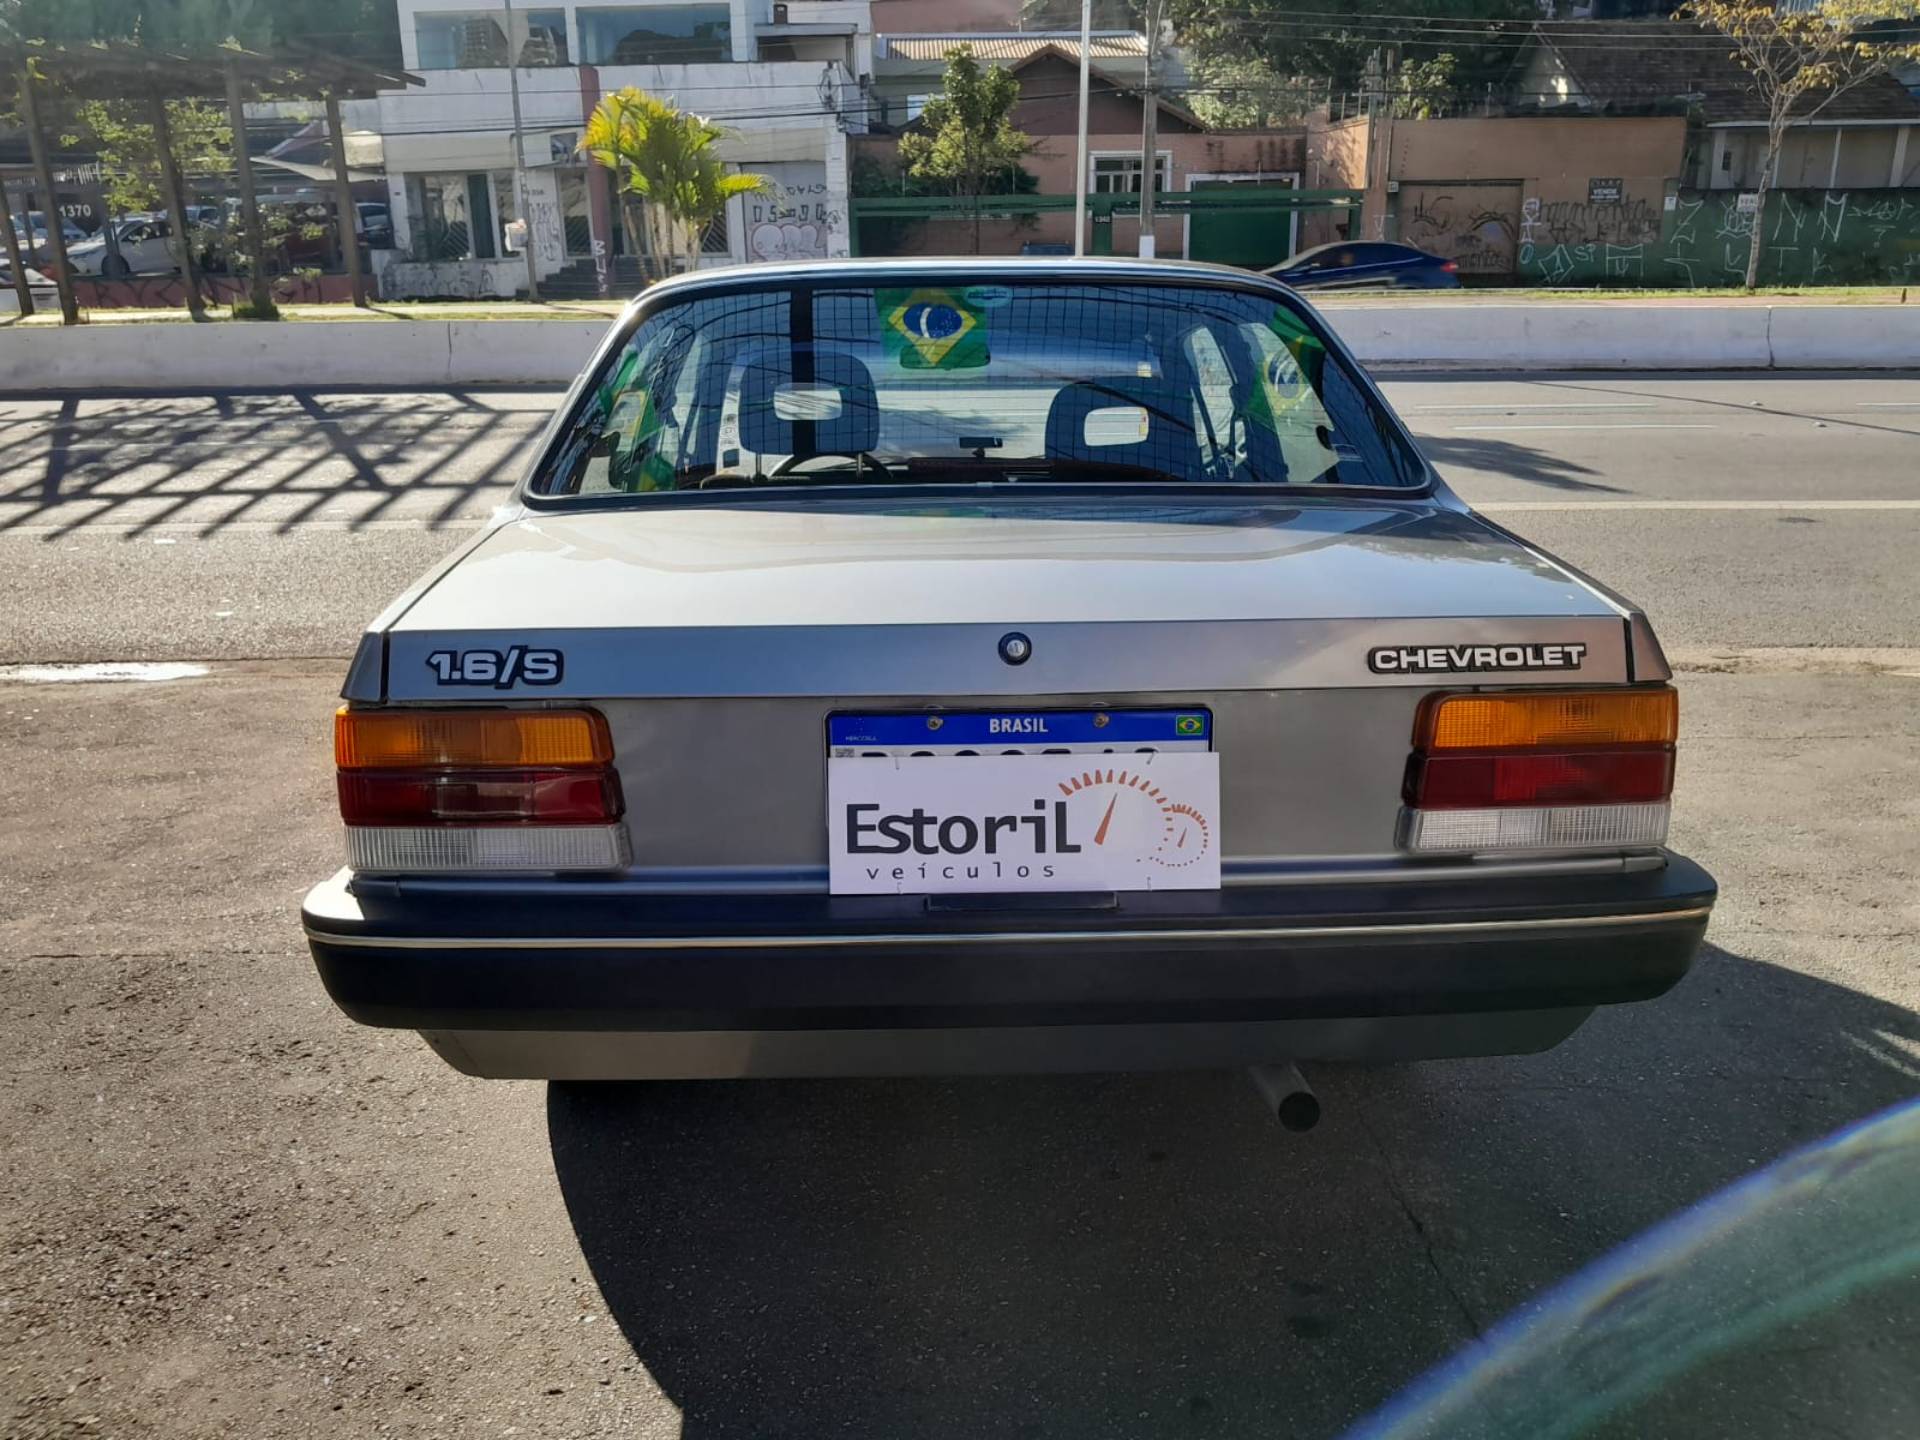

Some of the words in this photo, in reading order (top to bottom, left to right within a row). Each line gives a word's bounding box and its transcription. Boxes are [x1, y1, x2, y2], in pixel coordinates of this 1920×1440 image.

[59, 204, 91, 217] 1370
[427, 646, 562, 688] 1.6/S
[1371, 644, 1586, 672] CHEVROLET
[989, 718, 1049, 733] BRASIL
[866, 861, 1055, 880] veículos
